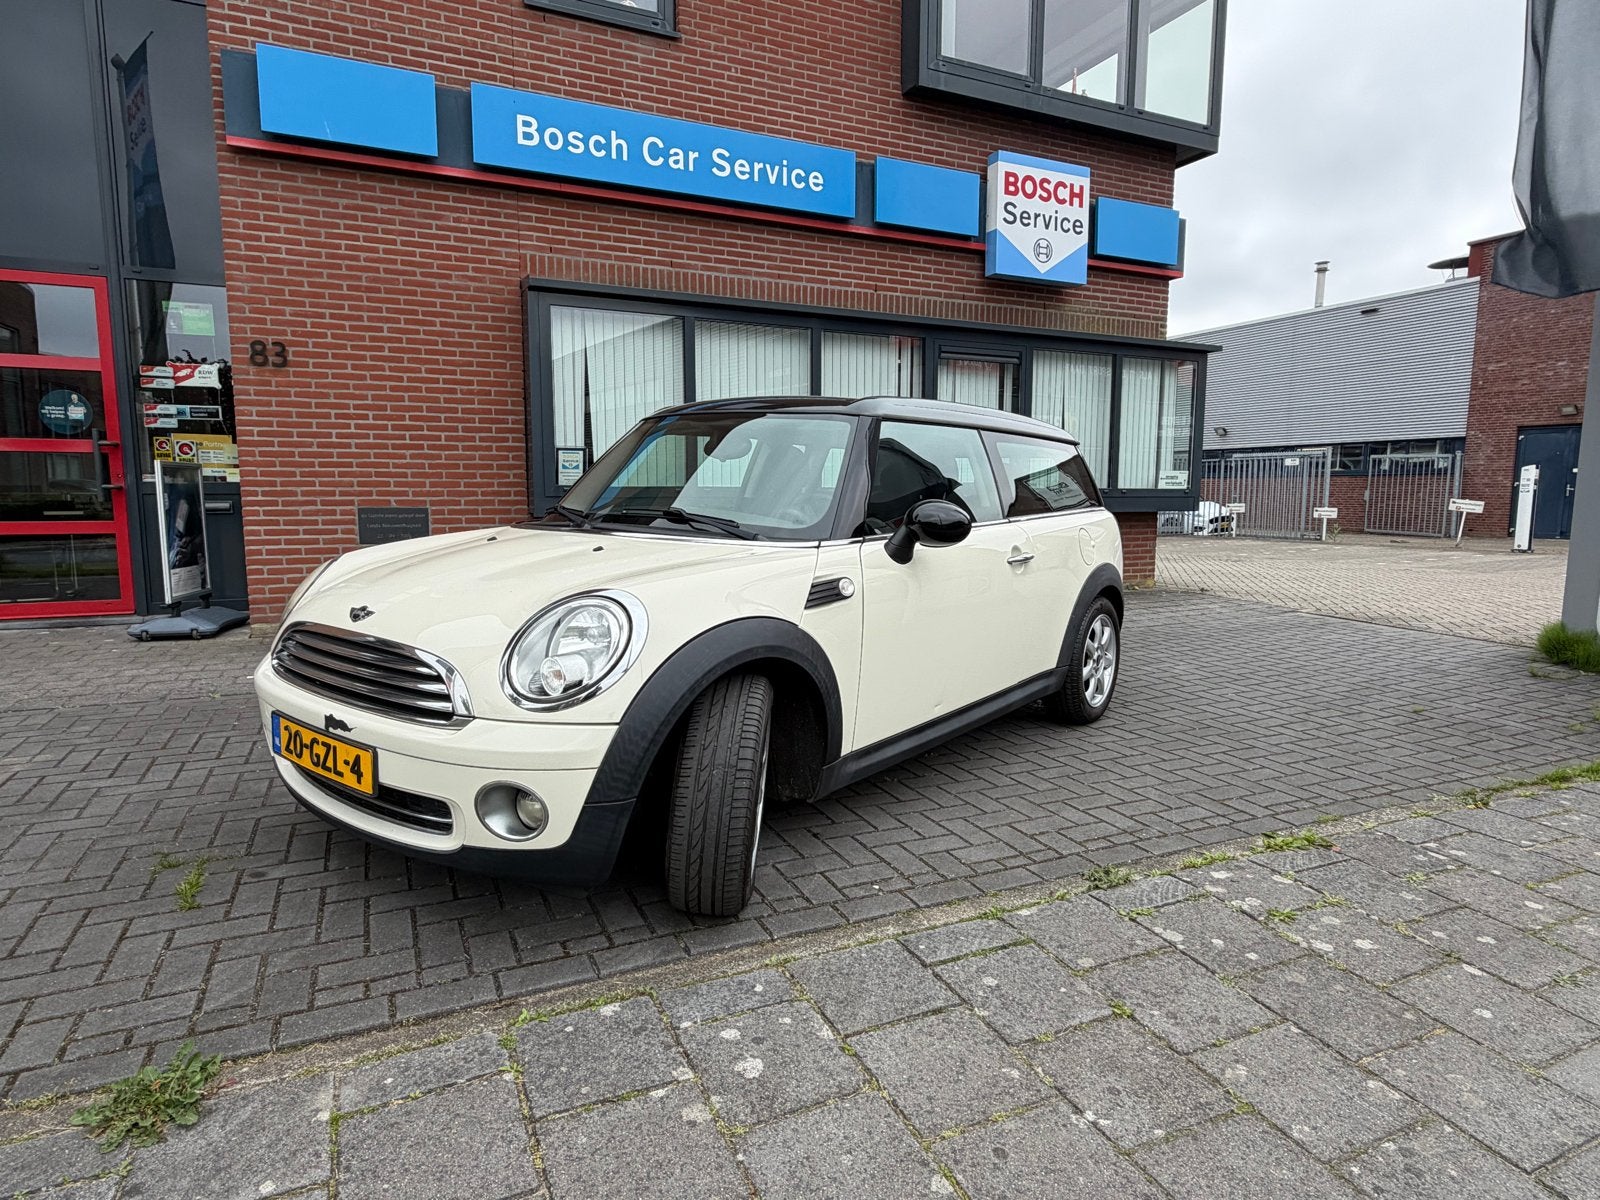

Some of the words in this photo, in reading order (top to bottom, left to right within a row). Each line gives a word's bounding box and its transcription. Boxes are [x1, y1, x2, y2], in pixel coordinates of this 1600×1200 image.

[515, 113, 629, 161] Bosch
[642, 136, 699, 172] Car
[711, 148, 824, 192] Service
[1003, 170, 1085, 209] BOSCH
[1002, 201, 1084, 236] Service
[250, 339, 288, 368] 83
[283, 724, 364, 785] 20-GZL-4
